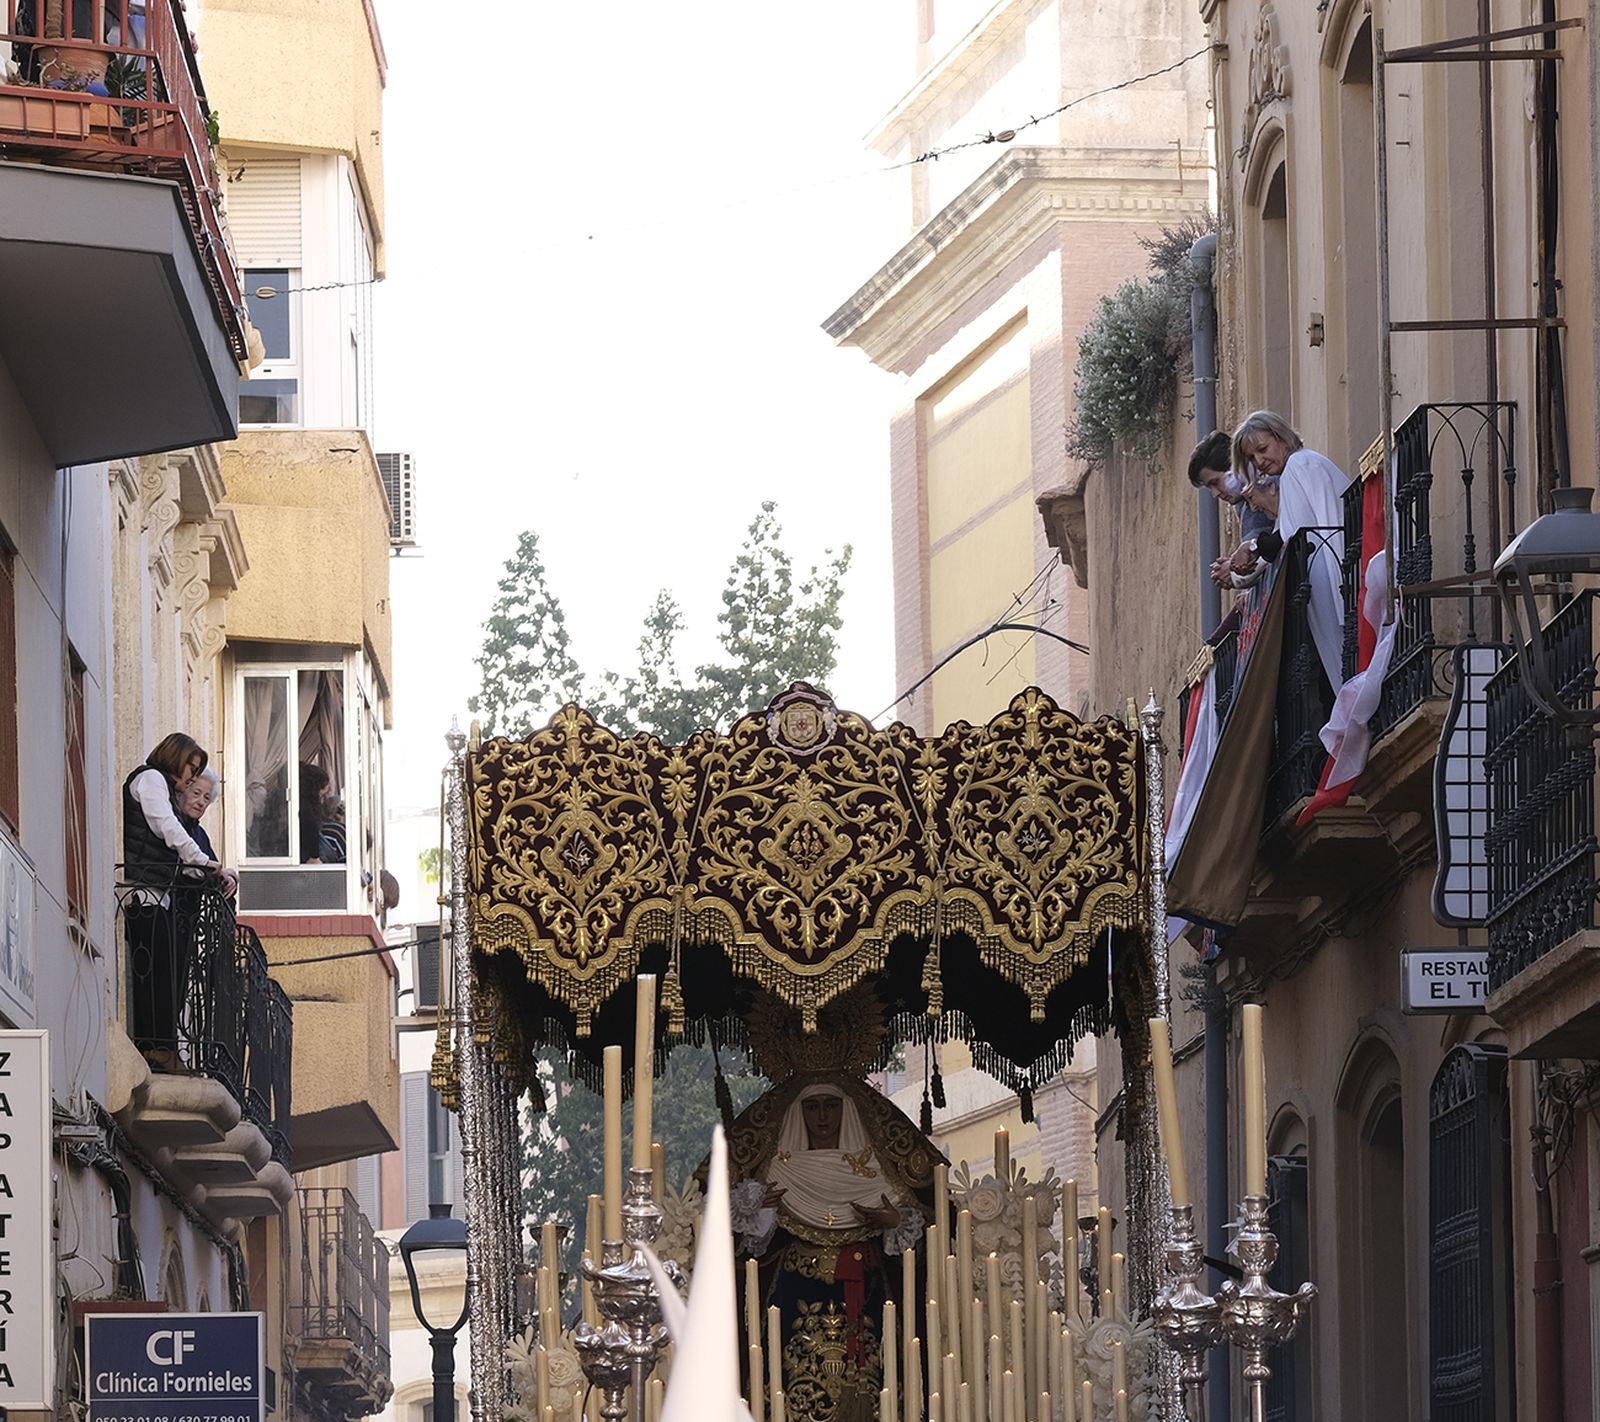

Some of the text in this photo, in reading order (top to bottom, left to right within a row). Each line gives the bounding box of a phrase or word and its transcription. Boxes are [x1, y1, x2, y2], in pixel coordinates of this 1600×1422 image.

[1430, 981, 1461, 999] EL
[146, 1330, 196, 1366] CF
[95, 1370, 253, 1394] Clínica Fornieles
